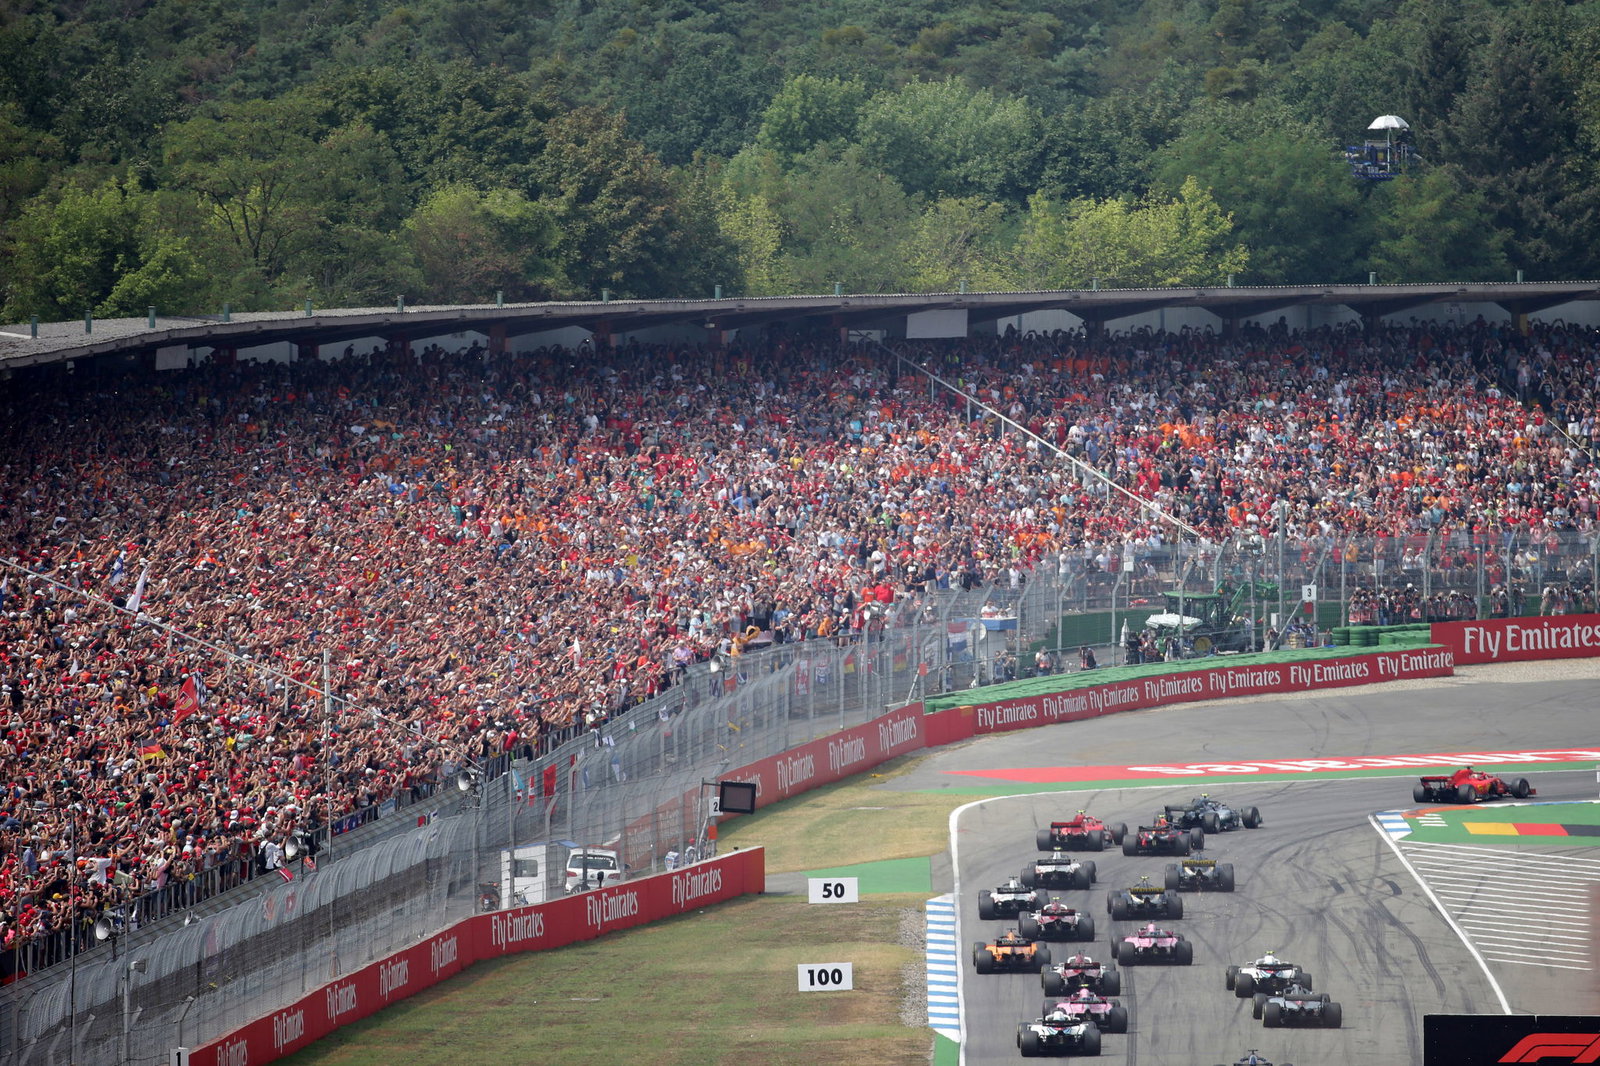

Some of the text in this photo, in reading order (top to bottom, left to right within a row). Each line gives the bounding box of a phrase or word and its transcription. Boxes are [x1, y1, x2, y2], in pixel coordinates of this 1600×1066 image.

[1464, 621, 1600, 658] Fly Emirates
[1209, 668, 1281, 693] Fly Emirates
[1290, 660, 1369, 687] Fly Emirates
[1377, 656, 1398, 676] Fly
[1043, 694, 1087, 719] Fly Emirates
[1089, 685, 1139, 712] Fly Emirates
[1144, 676, 1203, 702] Fly Emirates
[978, 703, 1037, 728] Fly Emirates
[878, 715, 917, 755] Fly Emirates
[777, 760, 788, 794] Fly
[788, 753, 814, 785] Emirates
[828, 735, 865, 774] Fly Emirates
[672, 868, 722, 908] Fly Emirates
[822, 883, 845, 898] 50
[586, 889, 638, 930] Fly Emirates
[492, 908, 544, 950] Fly Emirates
[431, 934, 458, 977] Fly Emirates
[380, 958, 409, 1000] Fly Emirates
[807, 968, 843, 986] 100
[326, 980, 357, 1024] Fly Emirates
[274, 1008, 304, 1053] Fly Emirates
